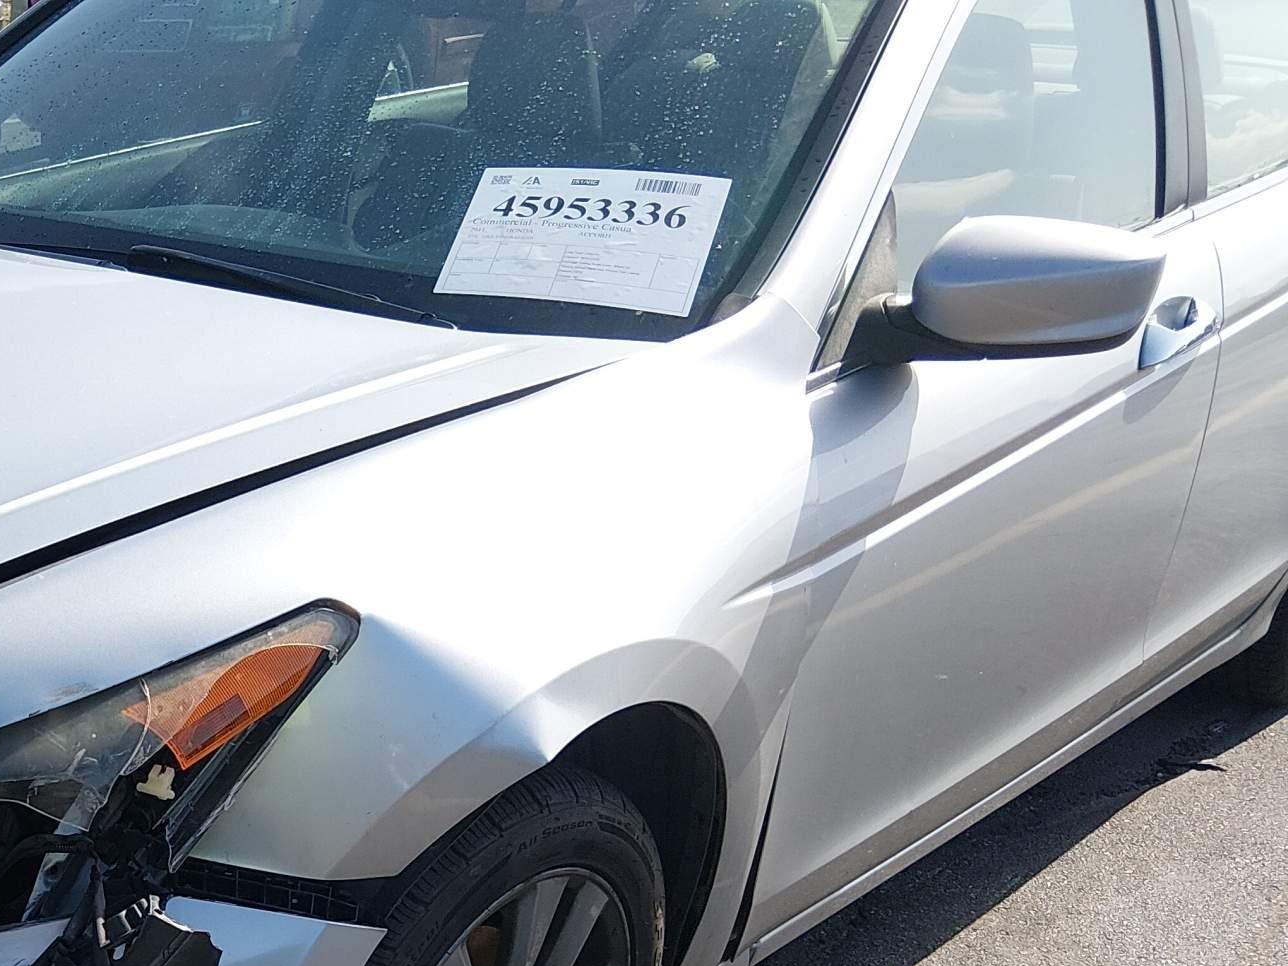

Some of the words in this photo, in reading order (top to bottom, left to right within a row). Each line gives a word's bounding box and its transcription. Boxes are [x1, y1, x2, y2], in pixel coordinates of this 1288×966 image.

[493, 195, 692, 229] 45953336
[541, 219, 599, 230] Progressive
[601, 223, 632, 233] Casua
